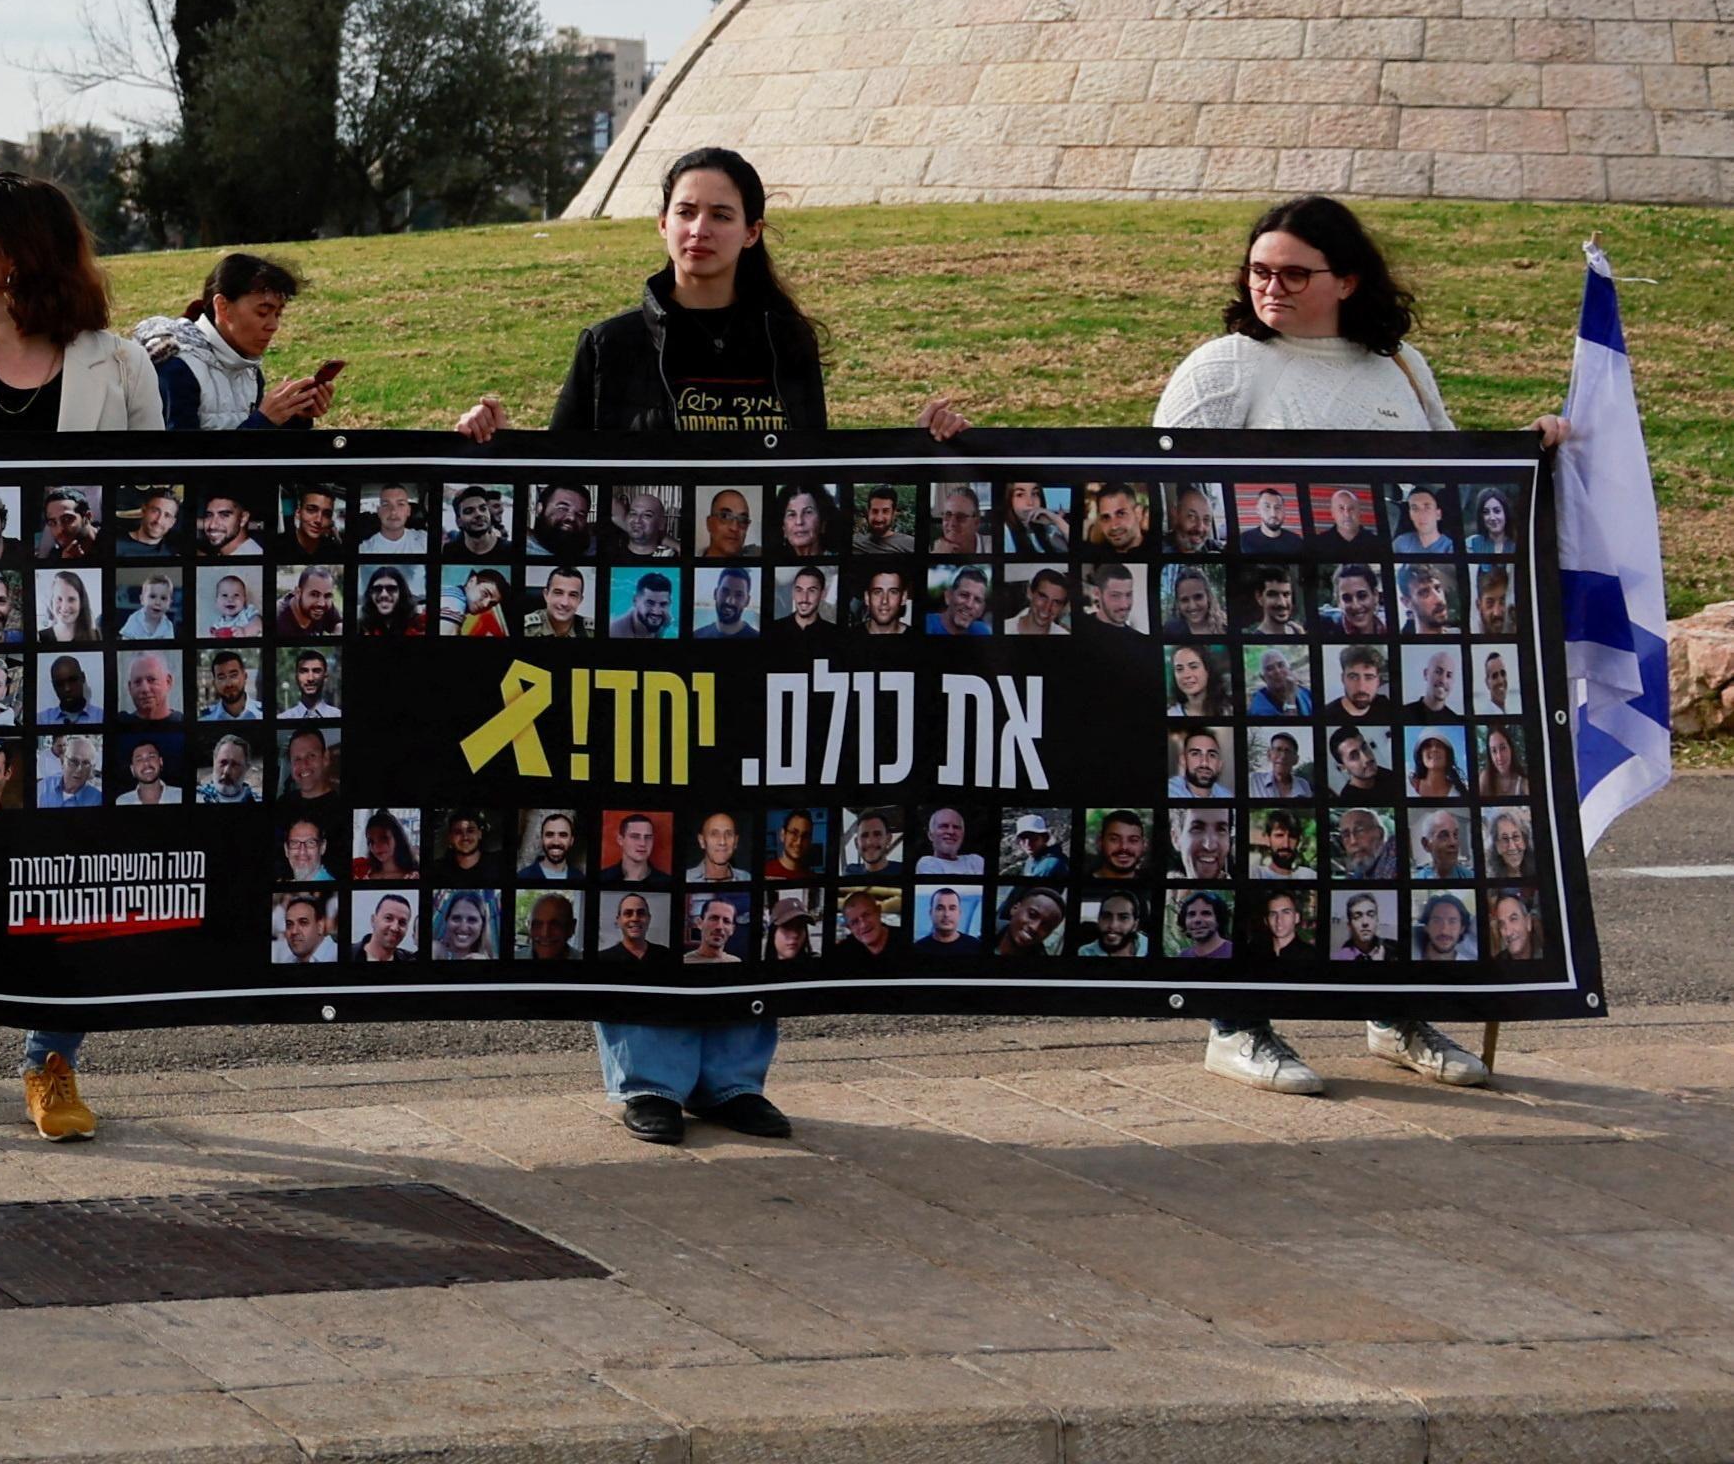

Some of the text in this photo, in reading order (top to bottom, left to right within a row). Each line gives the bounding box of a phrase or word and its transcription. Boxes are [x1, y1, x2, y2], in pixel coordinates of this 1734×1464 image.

[570, 659, 1049, 790] את כולם. יחד!
[8, 850, 206, 886] מטה המשפחות להחזרת
[8, 883, 206, 927] החטופים והנעדרים
